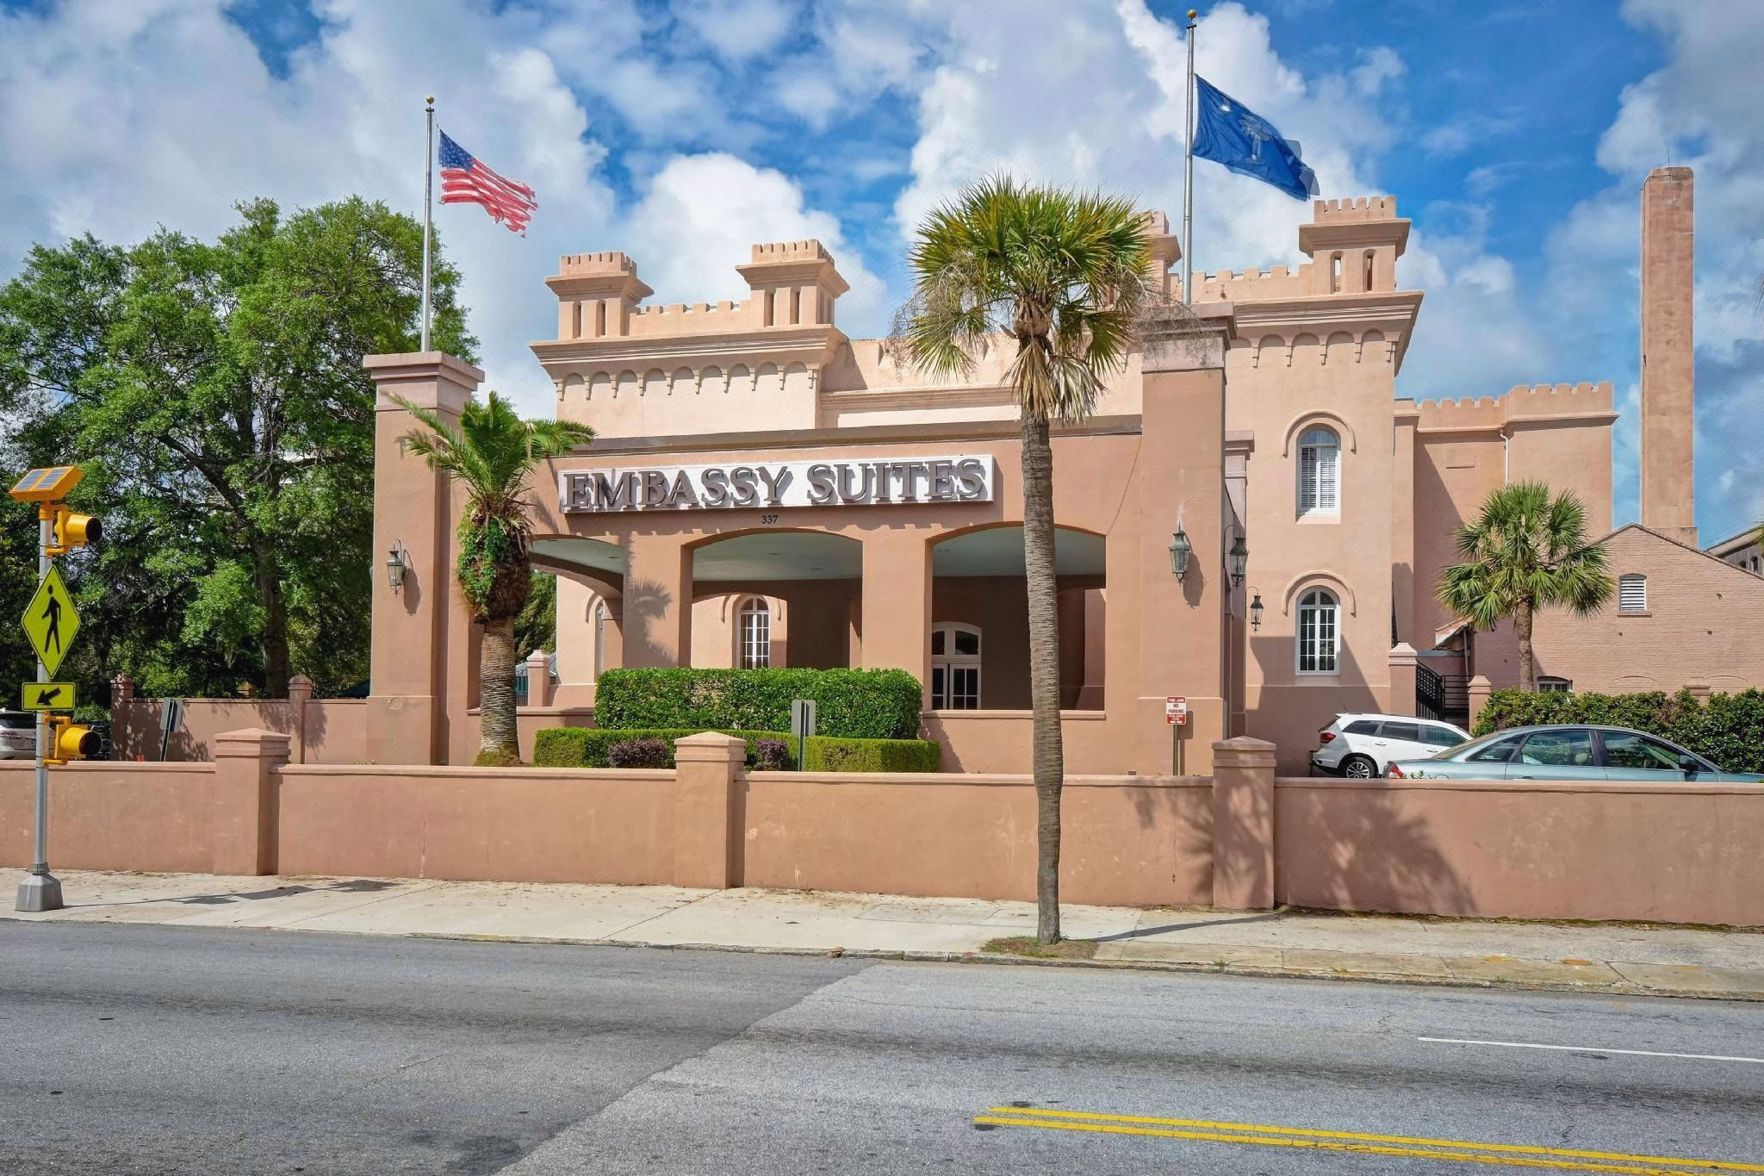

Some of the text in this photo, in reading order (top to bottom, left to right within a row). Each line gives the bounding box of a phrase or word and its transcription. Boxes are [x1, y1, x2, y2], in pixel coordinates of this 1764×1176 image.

[563, 458, 984, 508] EMBASSY SUITES
[761, 514, 778, 525] 337
